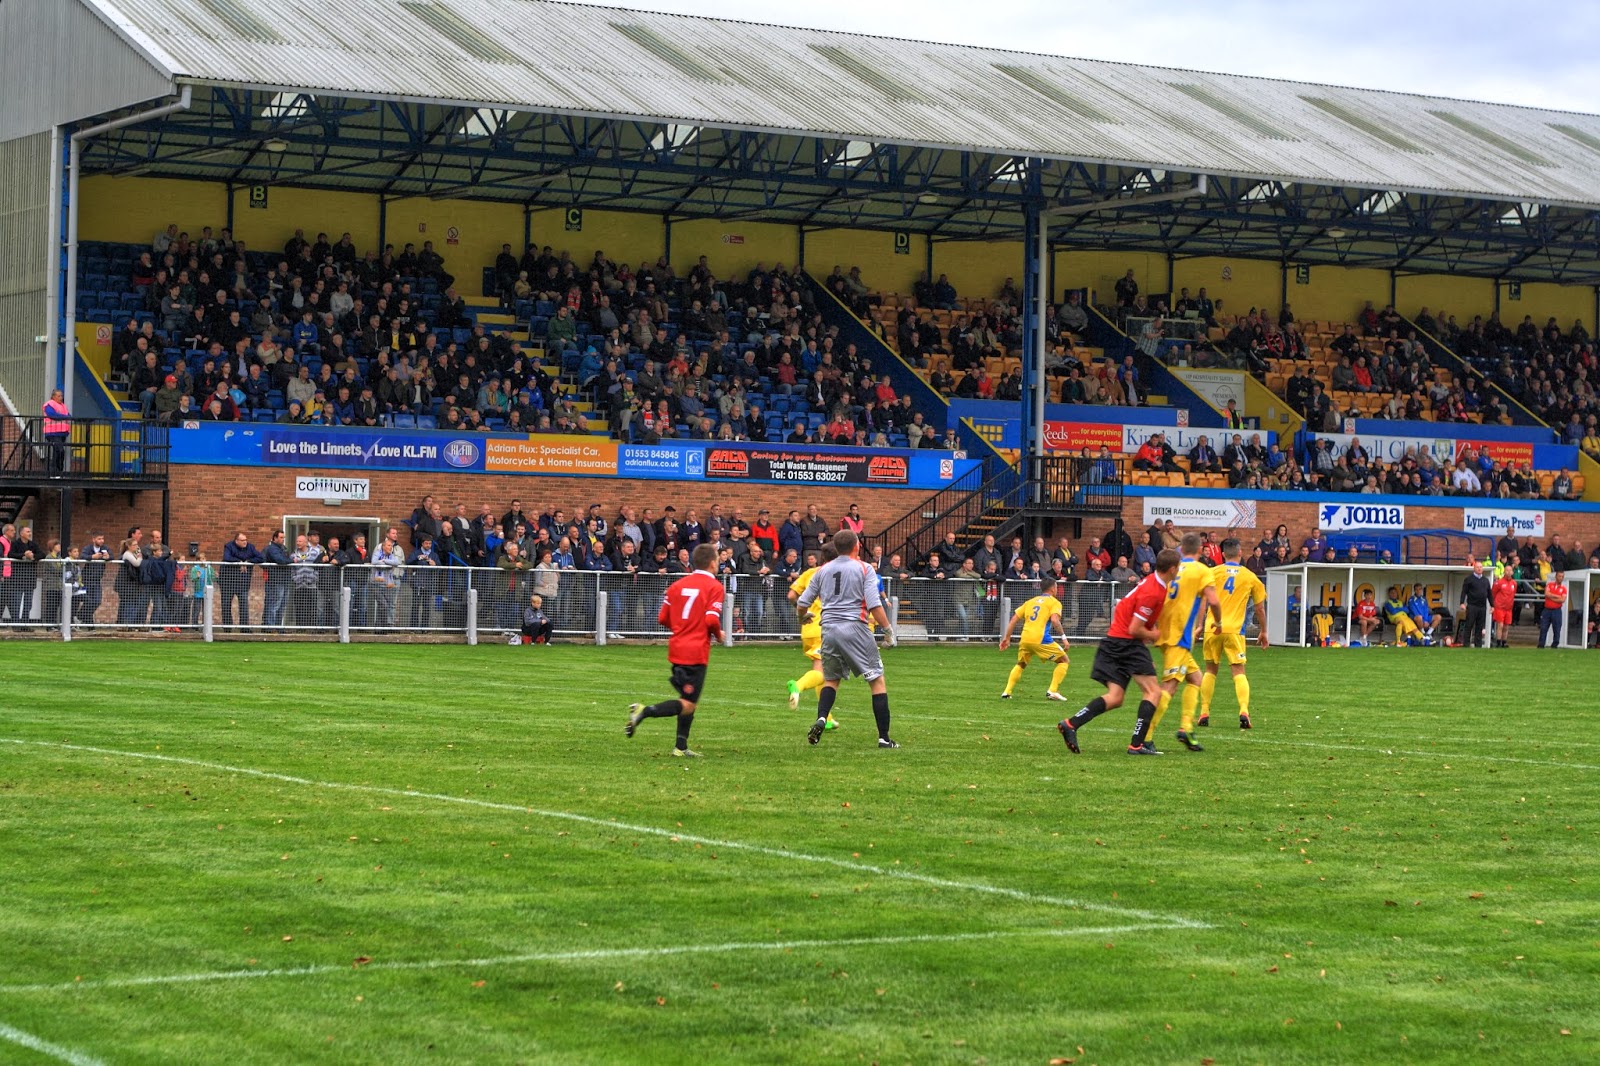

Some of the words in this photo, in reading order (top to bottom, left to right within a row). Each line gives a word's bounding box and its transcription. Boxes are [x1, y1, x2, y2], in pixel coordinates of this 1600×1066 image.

[253, 186, 265, 200] B
[567, 208, 580, 224] C
[896, 232, 908, 247] D
[1299, 265, 1308, 278] E
[1091, 429, 1122, 438] everything
[269, 440, 296, 454] Love
[299, 442, 319, 455] the
[320, 442, 362, 456] Linnets
[374, 444, 401, 457] Love
[402, 445, 437, 459] KL.FM
[487, 444, 516, 454] Adrian
[518, 445, 538, 454] Flux:
[540, 446, 581, 456] Specialist
[582, 447, 601, 457] Car,
[625, 449, 649, 459] 01553
[650, 451, 680, 460] 845845
[1505, 447, 1532, 455] everything
[487, 456, 537, 467] Motorcycle
[538, 458, 545, 466] &
[547, 458, 573, 467] Home
[575, 459, 617, 469] Insurance
[709, 450, 749, 463] BACO
[751, 451, 779, 461] Caring
[781, 453, 794, 462] for
[815, 454, 867, 463] Environment
[868, 456, 907, 469] BACO
[625, 459, 680, 468] adrianflux.co.uk
[711, 461, 747, 471] COMPAK
[769, 461, 786, 470] Total
[787, 462, 806, 470] Waste
[807, 462, 849, 473] Management
[770, 470, 786, 480] Tel:
[787, 471, 814, 481] 01553
[815, 472, 847, 482] 630247
[870, 468, 905, 477] COMPAK
[1151, 507, 1172, 515] BBC
[1195, 509, 1227, 517] NORFOLK
[1466, 515, 1489, 530] Lynn
[1490, 516, 1510, 529] Free
[1511, 516, 1535, 529] Press
[832, 571, 842, 595] 1
[1168, 576, 1181, 600] 5
[1222, 576, 1236, 594] 4
[681, 588, 700, 619] 7
[1029, 605, 1041, 621] 3
